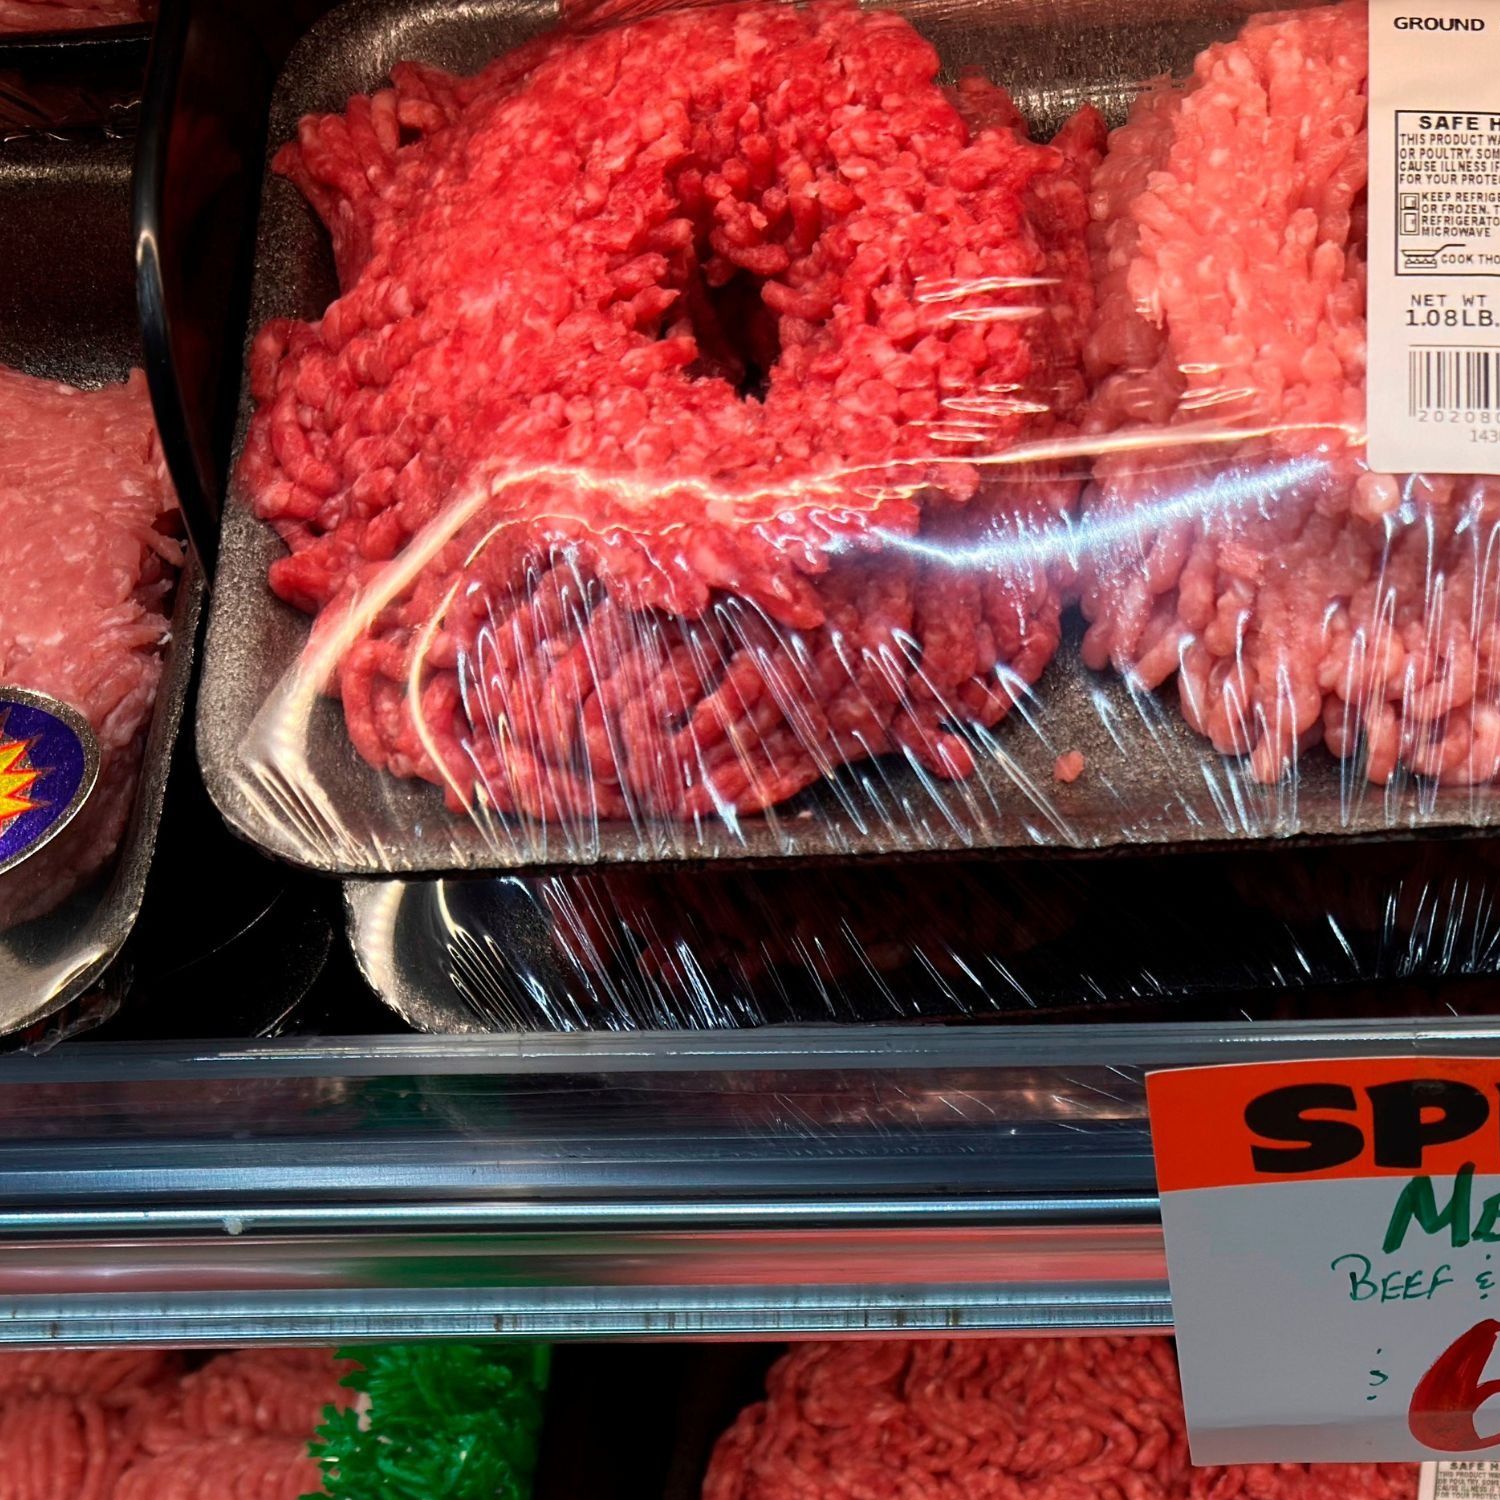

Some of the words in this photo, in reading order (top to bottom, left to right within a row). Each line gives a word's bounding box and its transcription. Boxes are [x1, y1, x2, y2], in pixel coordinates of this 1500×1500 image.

[1393, 16, 1485, 32] GROUND
[1419, 116, 1479, 132] SAFE
[1422, 192, 1452, 201] KEEP
[1422, 204, 1438, 214] OR
[1441, 204, 1489, 214] FROZEN.
[1422, 227, 1491, 237] MICROWAVE
[1441, 254, 1473, 264] COOK
[1411, 294, 1446, 307] NET
[1462, 295, 1487, 307] WT
[1405, 310, 1500, 328] 1.08LB.
[1331, 1251, 1454, 1304] BEEF
